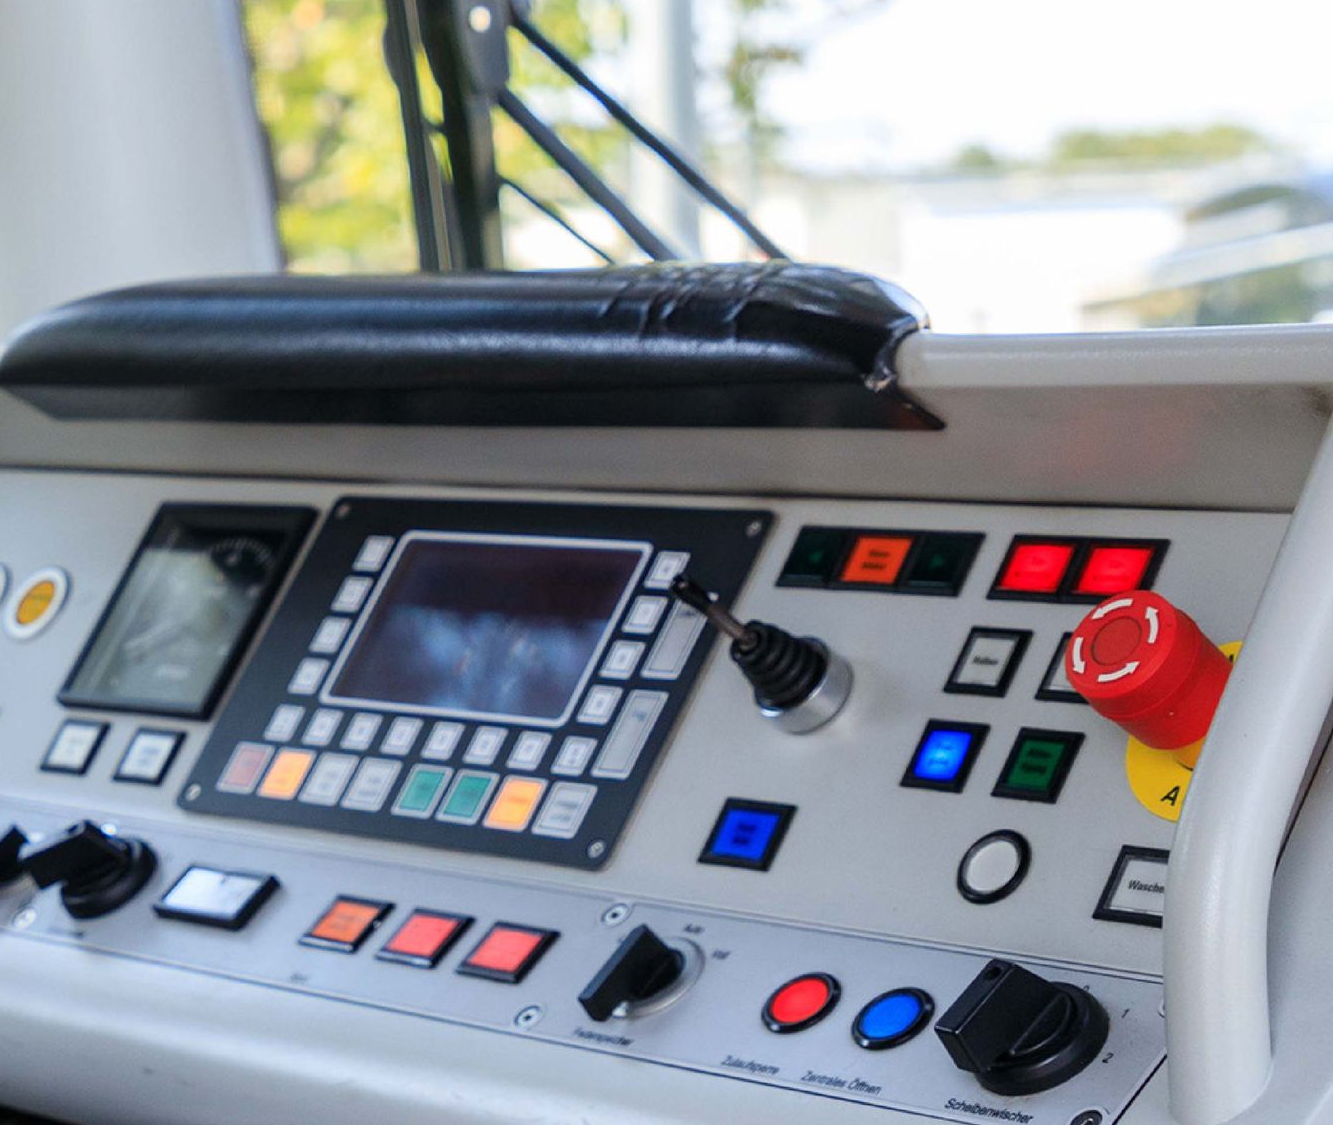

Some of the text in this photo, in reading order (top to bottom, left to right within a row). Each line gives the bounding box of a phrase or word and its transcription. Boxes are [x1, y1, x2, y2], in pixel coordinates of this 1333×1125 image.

[1121, 1008, 1131, 1019] 1
[1101, 1052, 1115, 1064] 2
[944, 1097, 1035, 1125] Scheibenwischer
